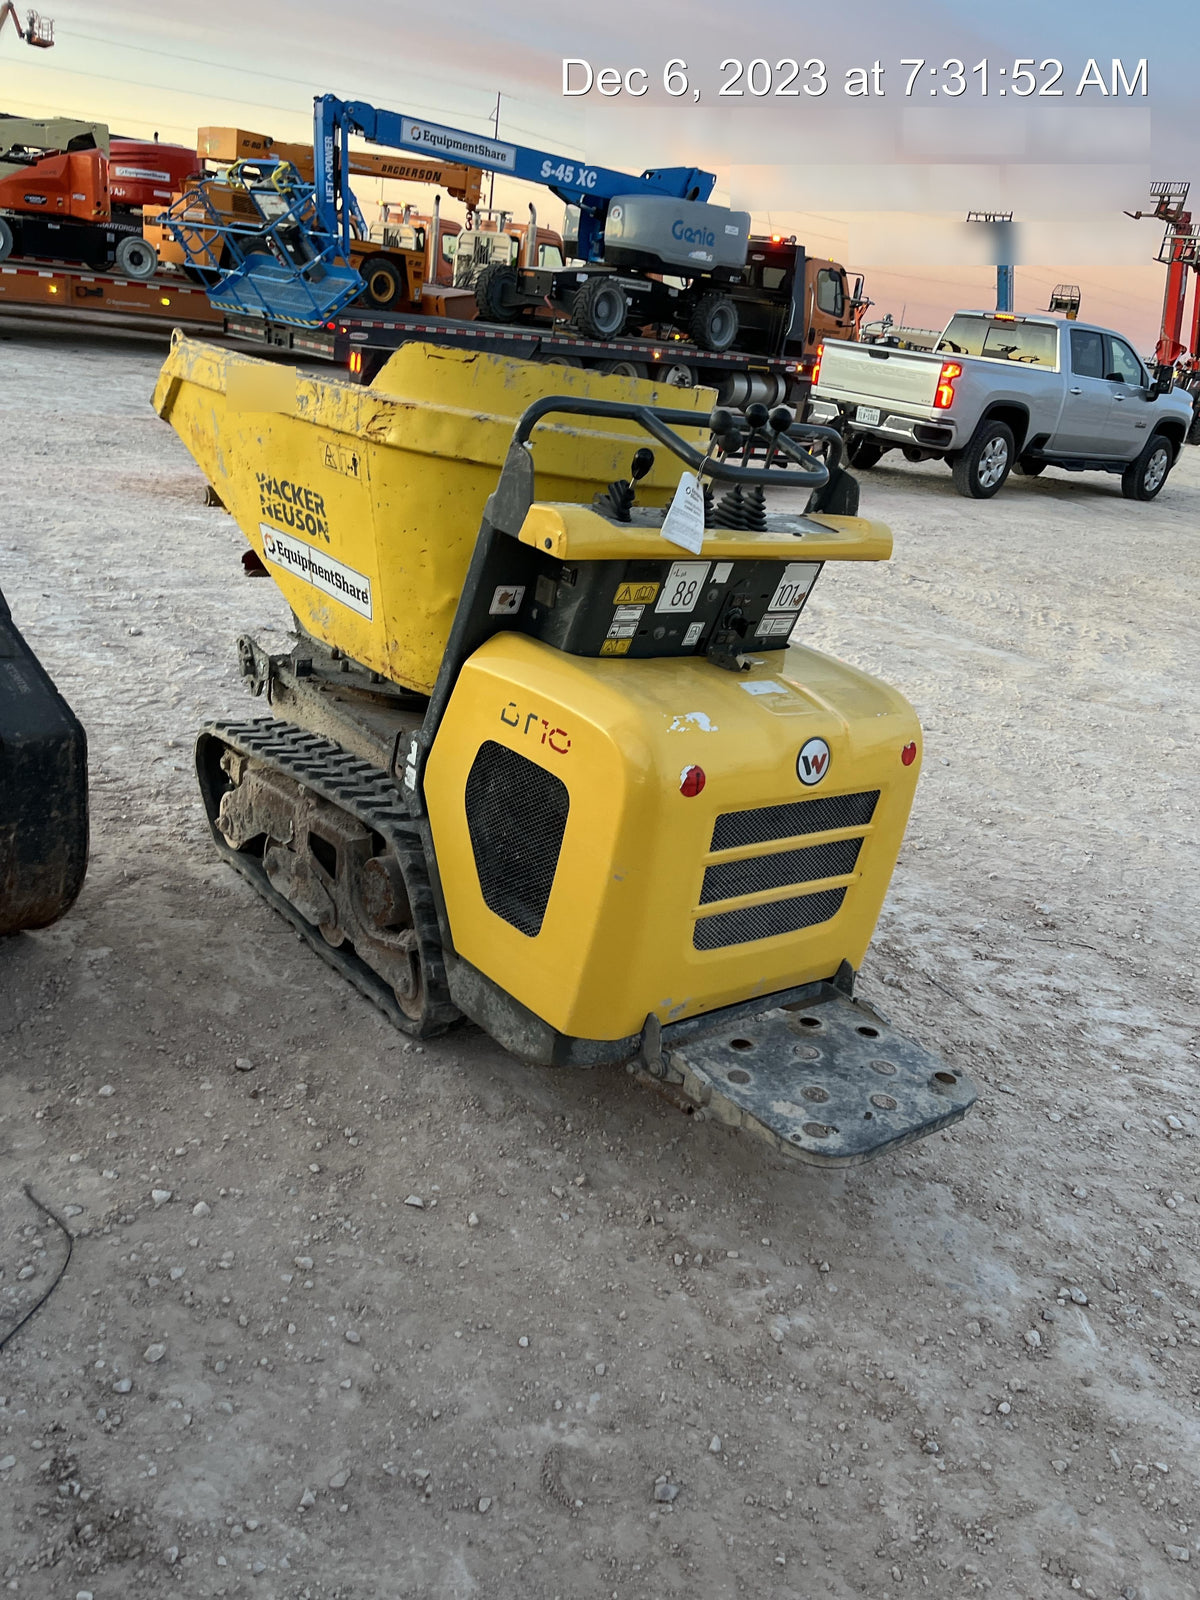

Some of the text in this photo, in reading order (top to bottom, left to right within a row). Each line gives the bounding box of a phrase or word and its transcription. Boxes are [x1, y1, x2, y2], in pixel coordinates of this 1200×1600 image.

[422, 129, 508, 162] EquipmentShare
[324, 135, 335, 204] LIFT POWER
[540, 160, 599, 189] S-45 XC
[671, 219, 716, 248] Genie
[255, 472, 327, 518] WACKER
[259, 494, 331, 544] NEUSON
[276, 539, 369, 605] EquipmentShare
[671, 580, 698, 606] 88
[774, 583, 800, 607] 101
